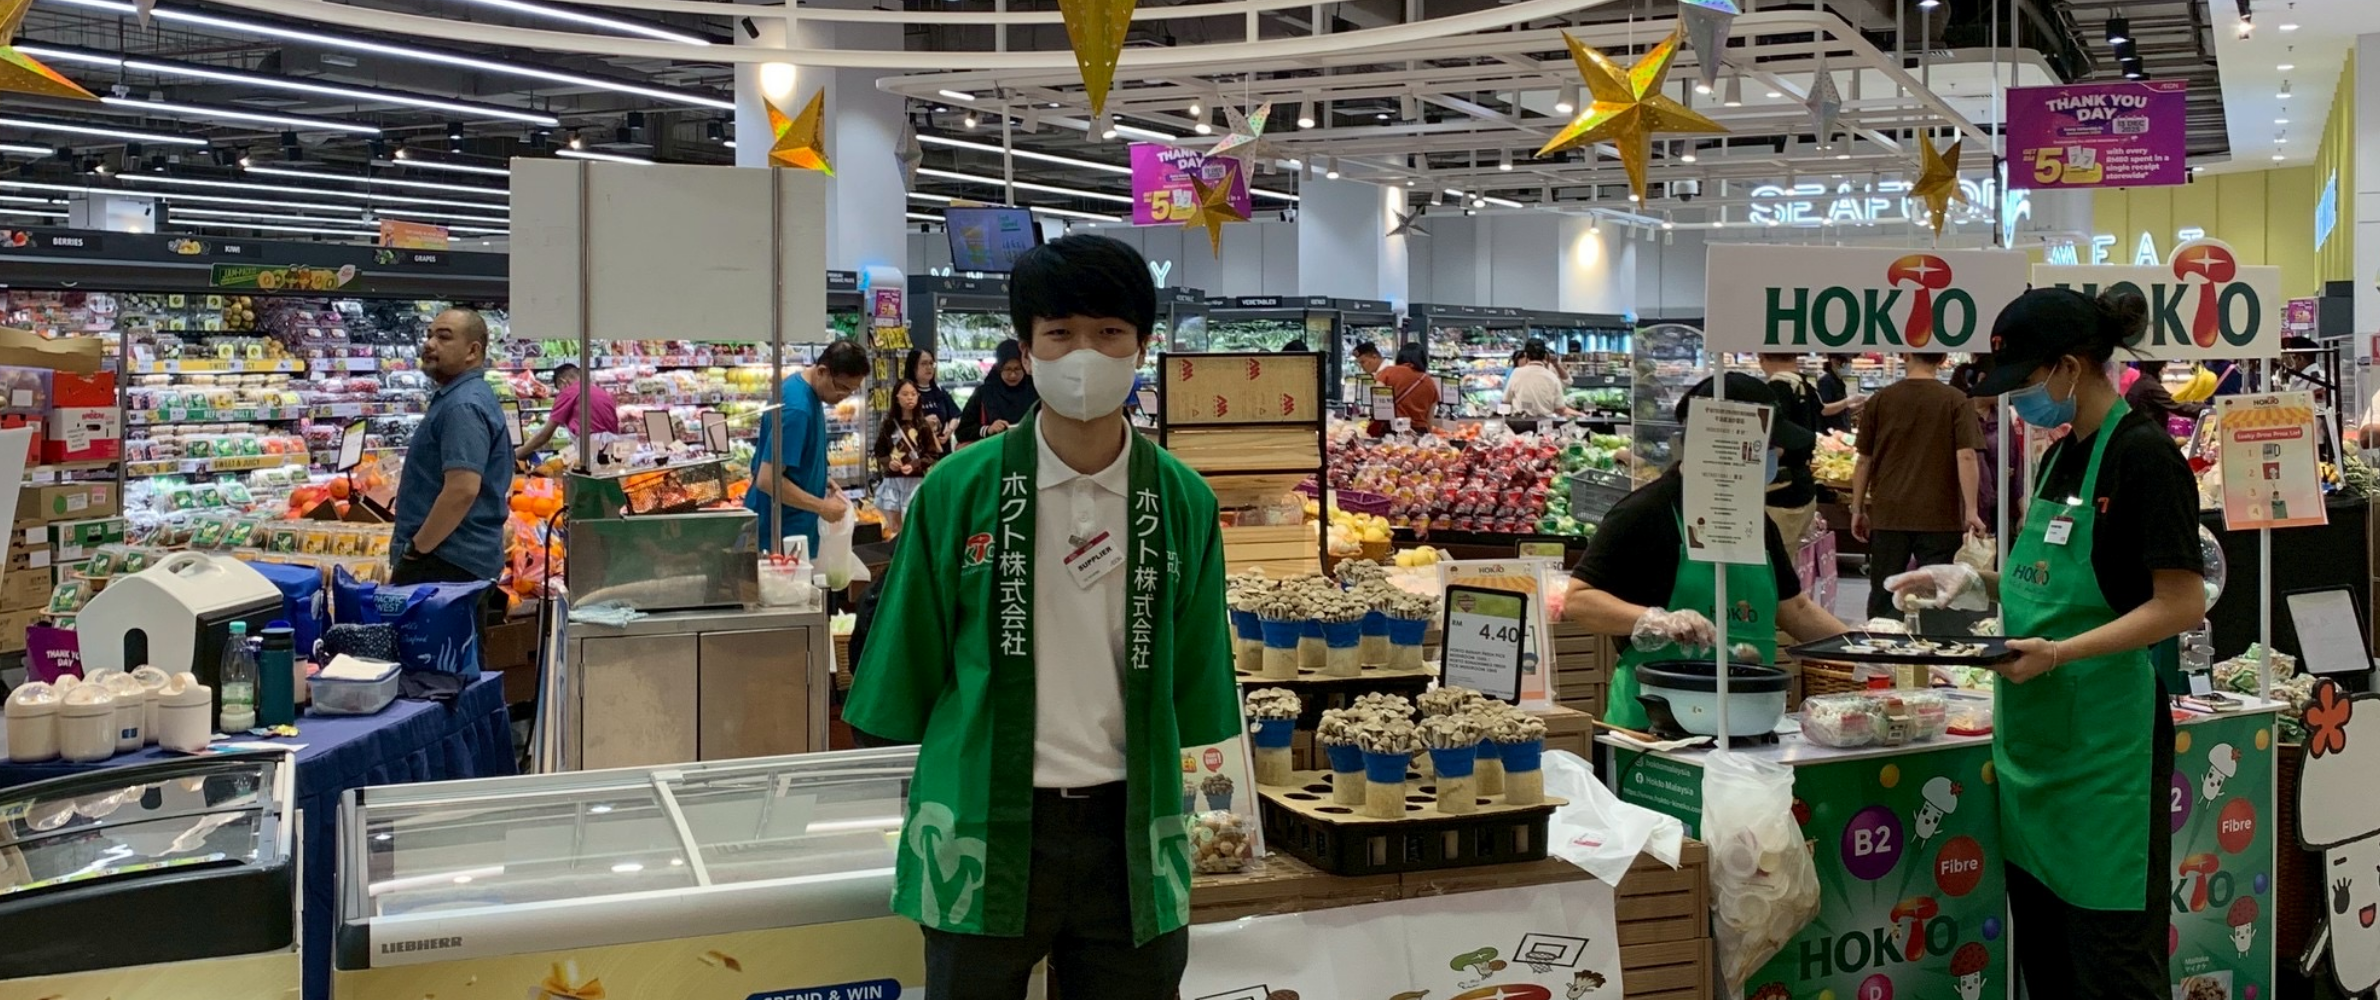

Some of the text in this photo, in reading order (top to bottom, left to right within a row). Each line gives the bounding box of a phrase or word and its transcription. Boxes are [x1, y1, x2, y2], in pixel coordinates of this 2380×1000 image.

[2045, 94, 2148, 112] THANK YOU
[2076, 108, 2118, 122] DAY
[2126, 148, 2148, 156] every
[2130, 156, 2153, 164] spent
[1178, 158, 1206, 169] DAY
[2034, 147, 2064, 184] 5
[2106, 163, 2160, 174] single receipt
[1151, 190, 1170, 220] 5
[53, 237, 83, 247] BERRIES
[414, 254, 436, 263] GRAPES
[1764, 254, 1977, 348] HOKTO
[2054, 245, 2261, 348] KTO
[2253, 396, 2279, 406] HOKTO
[1000, 472, 1028, 656] ホクト株式会社
[1078, 545, 1113, 572] SUPPLIER
[1131, 487, 1160, 670] ホクト株式会社
[374, 594, 403, 604] PACIFIC
[376, 603, 399, 613] WEST
[1709, 600, 1758, 624] HKTO
[1479, 623, 1519, 643] 4.40
[46, 650, 70, 659] THANK
[58, 658, 74, 667] DAY
[1645, 776, 1694, 796] Hokto Malaysia
[2222, 819, 2252, 833] Fibre
[1854, 825, 1892, 856] B2
[1941, 857, 1979, 875] Fibre
[381, 936, 463, 954] LIEBHERR
[1800, 896, 1958, 981] HOKTO
[829, 989, 841, 1000] &
[847, 985, 883, 999] WIN
